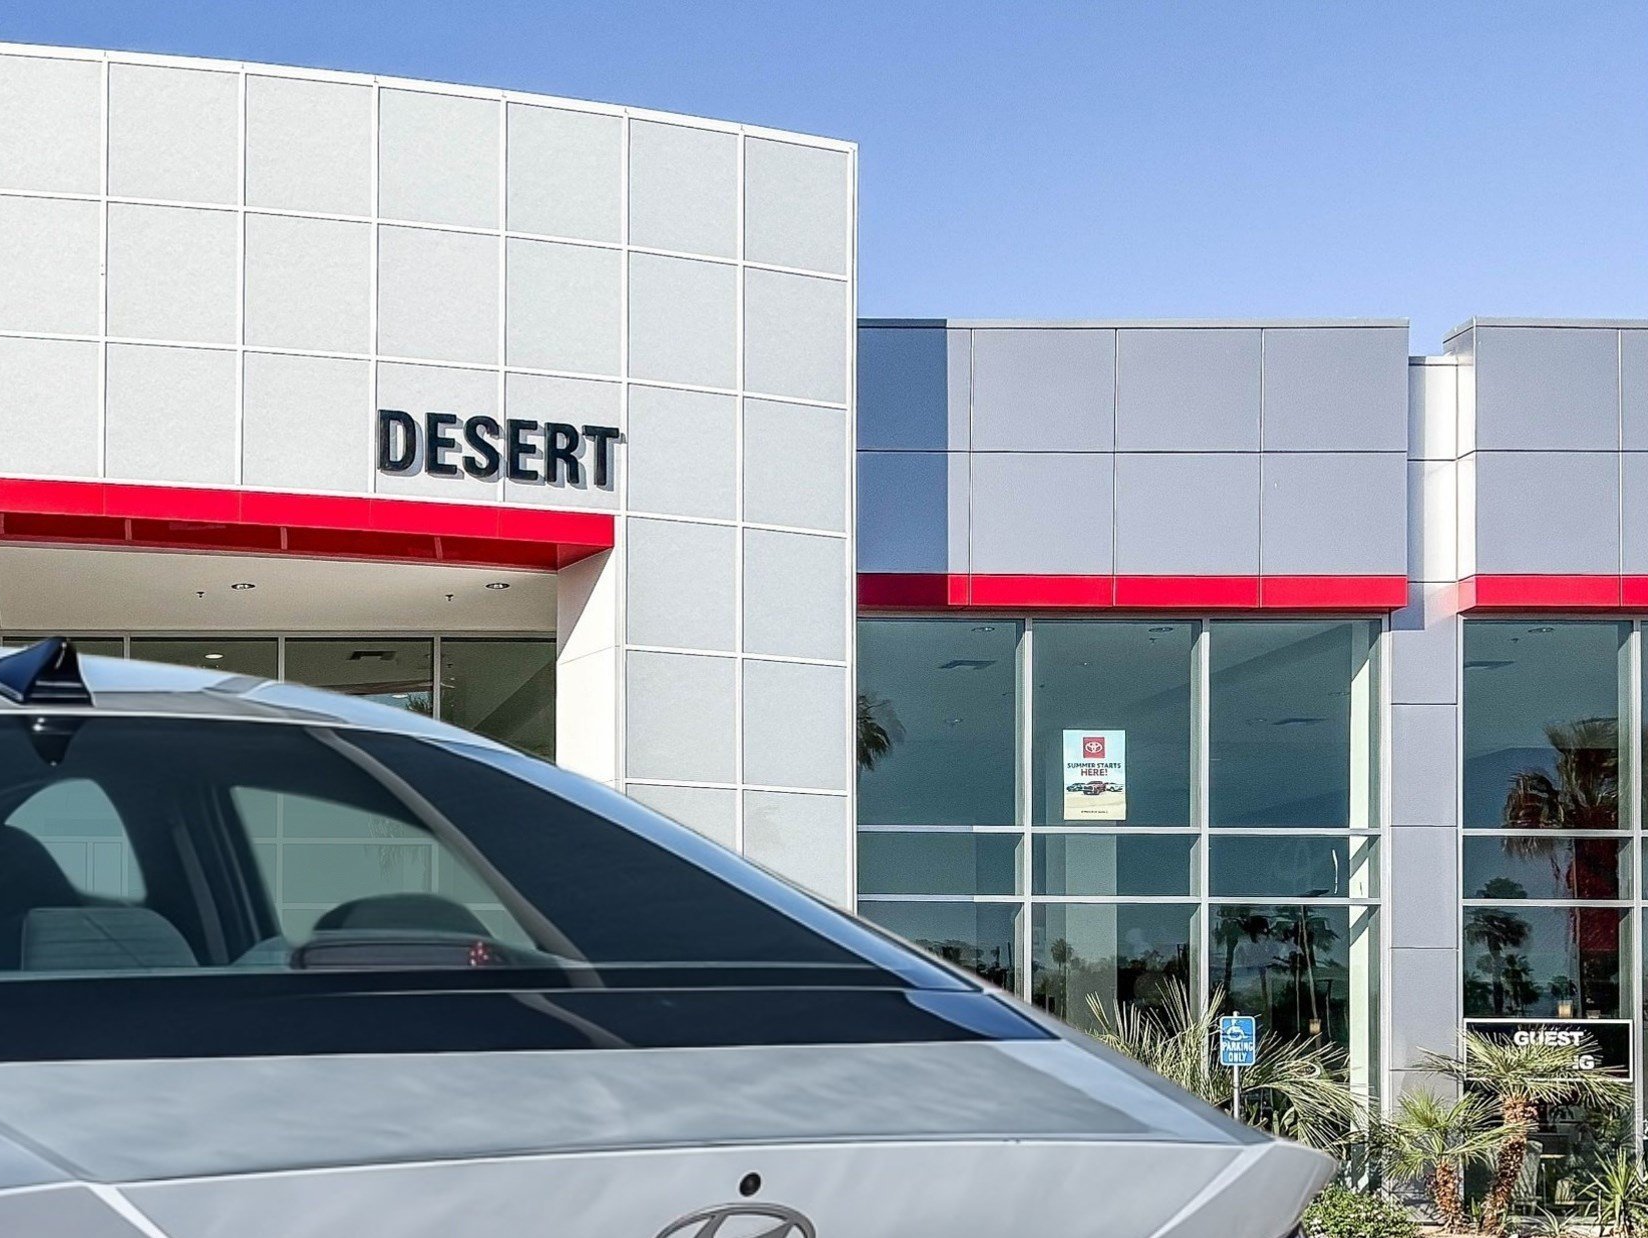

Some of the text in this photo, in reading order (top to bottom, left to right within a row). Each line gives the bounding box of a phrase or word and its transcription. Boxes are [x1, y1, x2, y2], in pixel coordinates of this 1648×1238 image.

[376, 408, 621, 487] DESERT
[1514, 1031, 1584, 1046] GUEST
[1223, 1042, 1253, 1052] PARKING
[1228, 1053, 1247, 1063] ONLY
